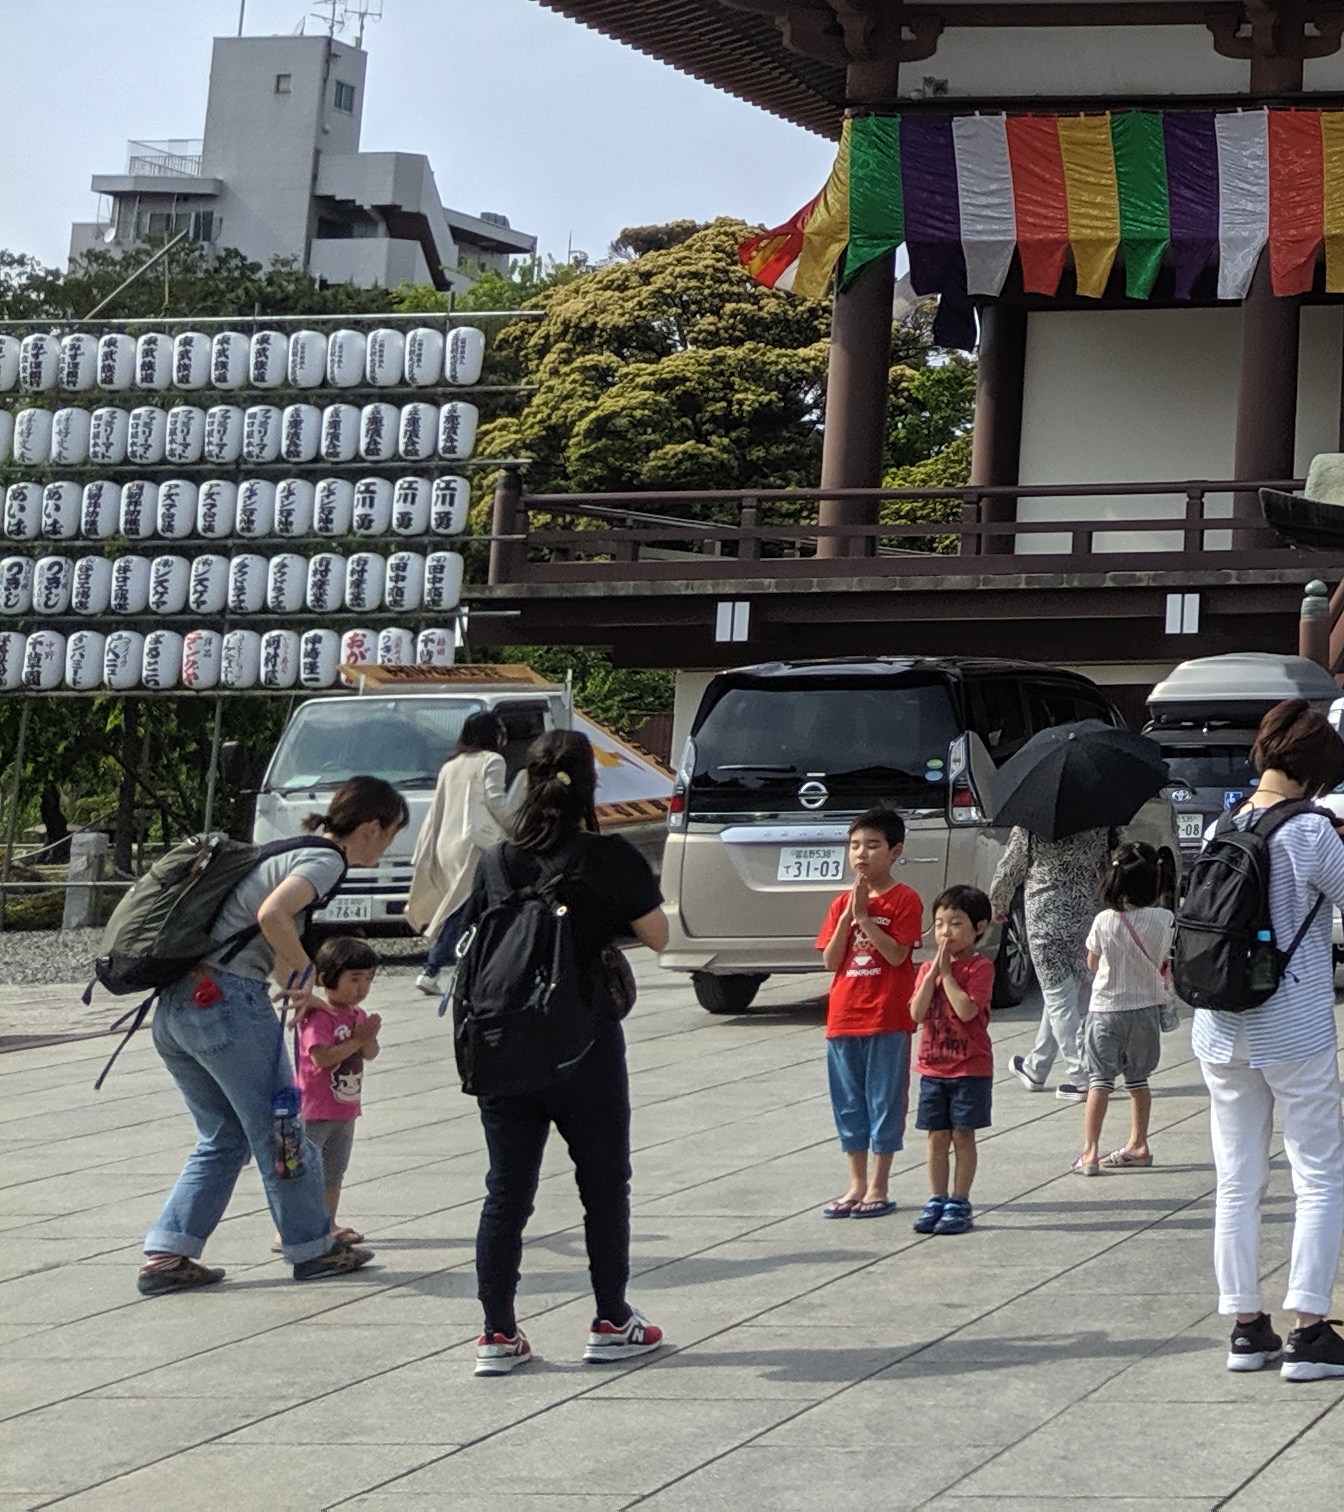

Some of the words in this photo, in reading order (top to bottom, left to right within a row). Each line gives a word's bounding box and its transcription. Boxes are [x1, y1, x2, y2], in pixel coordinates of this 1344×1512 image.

[783, 865, 792, 874] て
[793, 860, 840, 878] 31-03
[336, 906, 368, 919] 76-41
